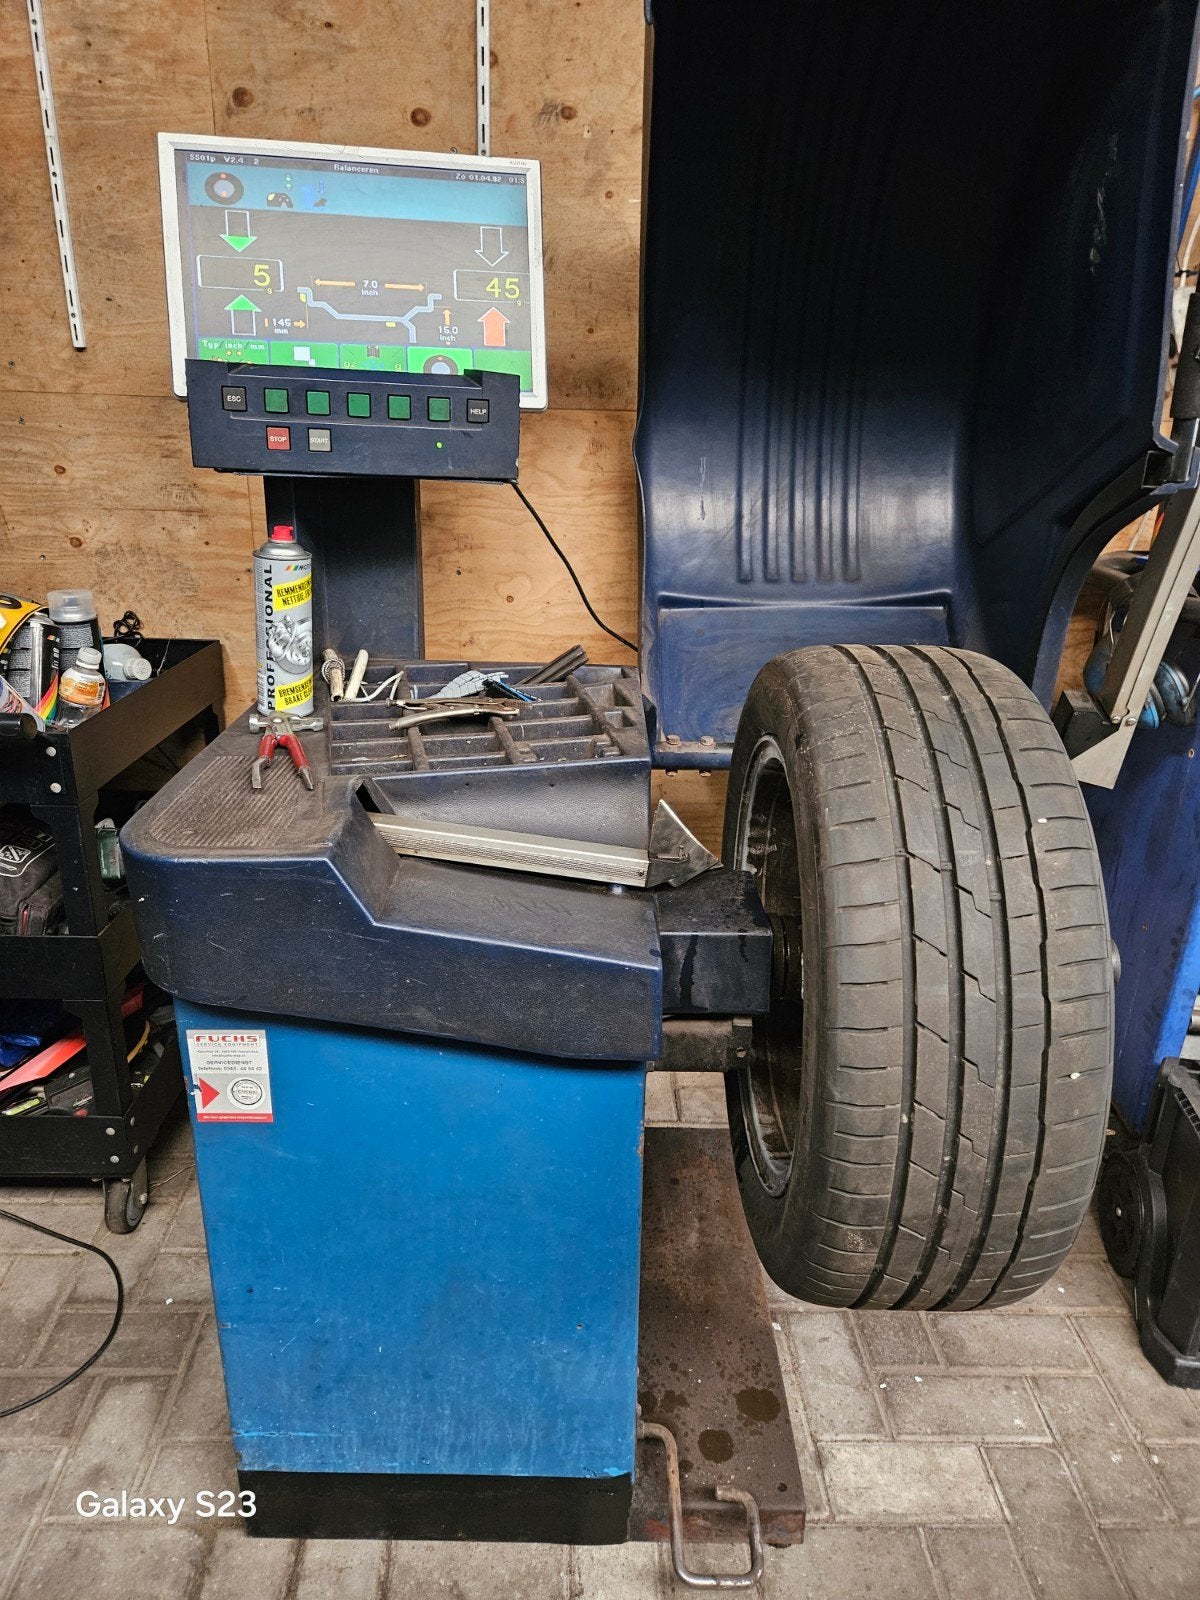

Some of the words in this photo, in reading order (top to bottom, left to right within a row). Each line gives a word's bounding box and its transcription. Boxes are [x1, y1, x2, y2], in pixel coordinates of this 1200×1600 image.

[223, 156, 244, 164] V2.4
[333, 163, 380, 174] Balanceren
[455, 172, 466, 180] Zo
[253, 264, 271, 287] 5
[362, 280, 379, 289] 7.0
[485, 277, 520, 299] 45
[361, 289, 379, 297] inch
[272, 318, 293, 328] 145
[274, 327, 289, 335] mm
[439, 326, 459, 335] 15.0
[227, 395, 242, 403] ESC
[269, 435, 288, 443] STOP
[195, 1035, 258, 1043] FUCHS
